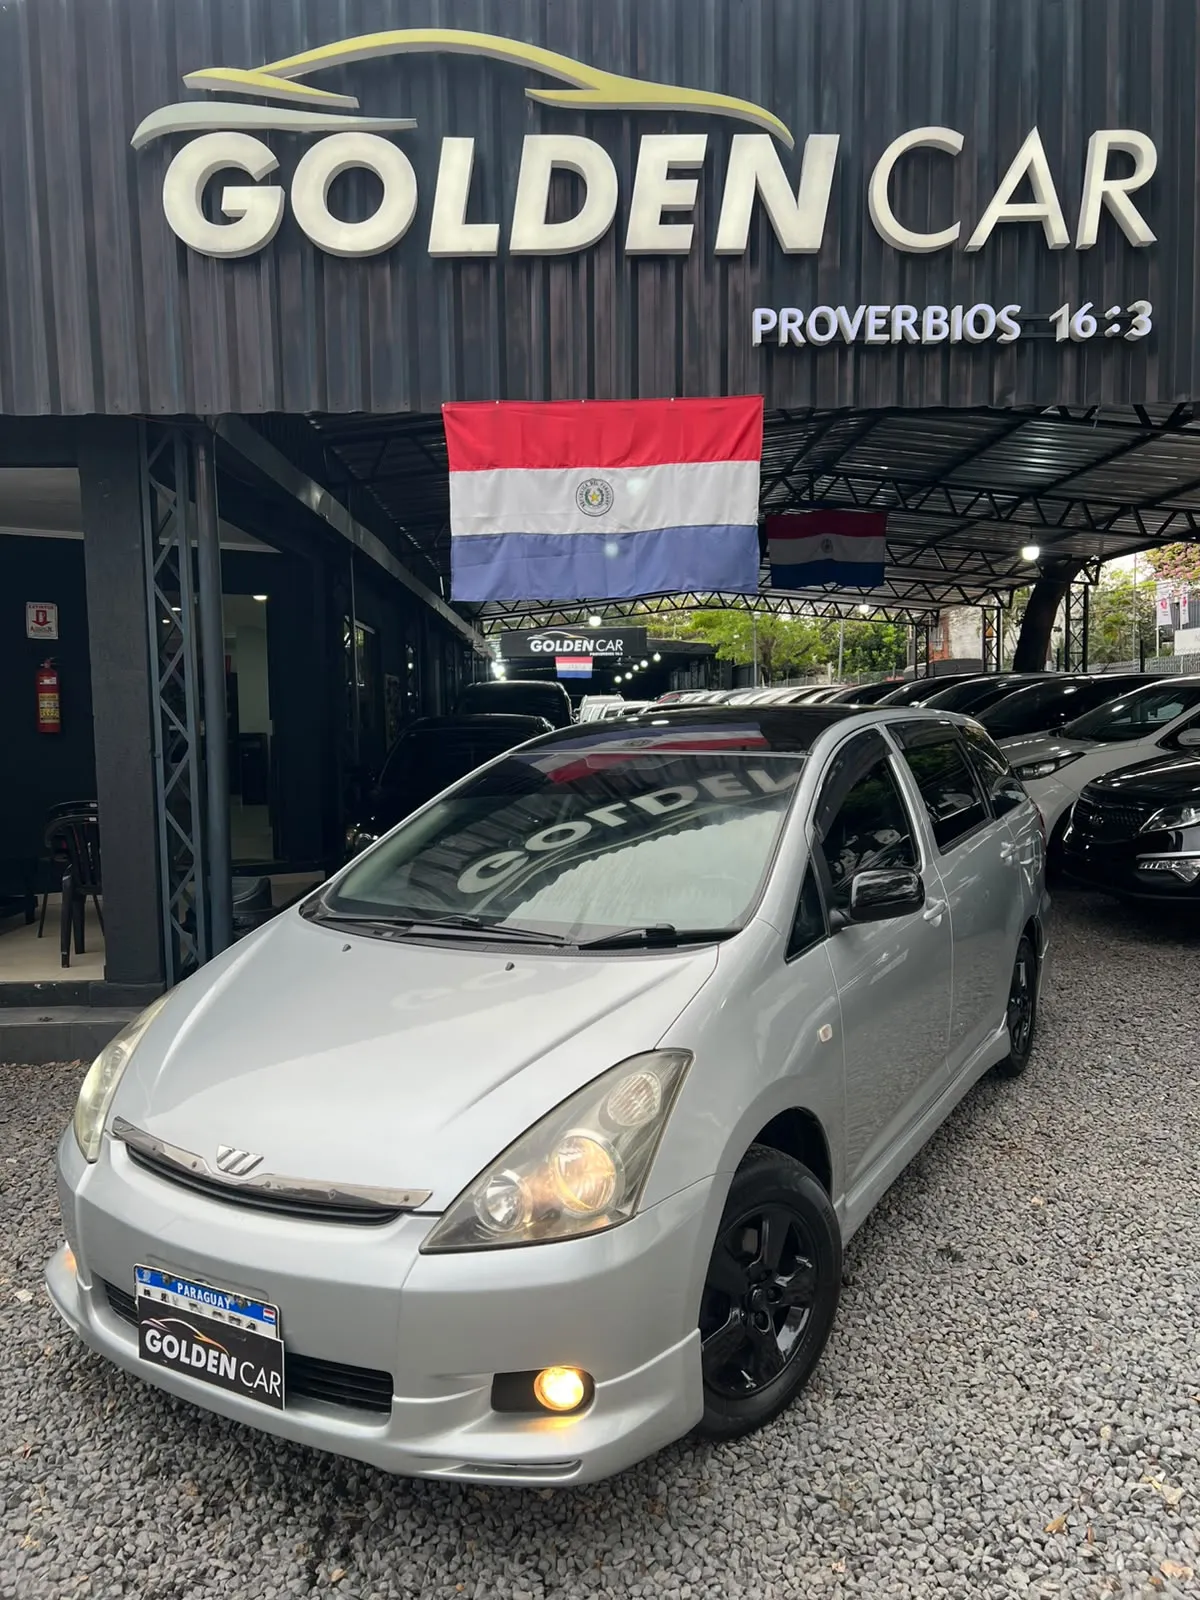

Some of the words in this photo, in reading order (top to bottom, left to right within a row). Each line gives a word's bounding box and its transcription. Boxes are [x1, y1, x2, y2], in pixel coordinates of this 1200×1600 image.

[163, 131, 840, 259] GOLDEN
[868, 126, 1159, 254] CAR
[752, 303, 1022, 348] PROVERBIOS
[530, 639, 594, 653] GOLDEN
[595, 639, 624, 652] CAR
[176, 1282, 232, 1310] PARAGUAY
[145, 1328, 237, 1381] GOLDEN
[239, 1361, 282, 1398] CAR
